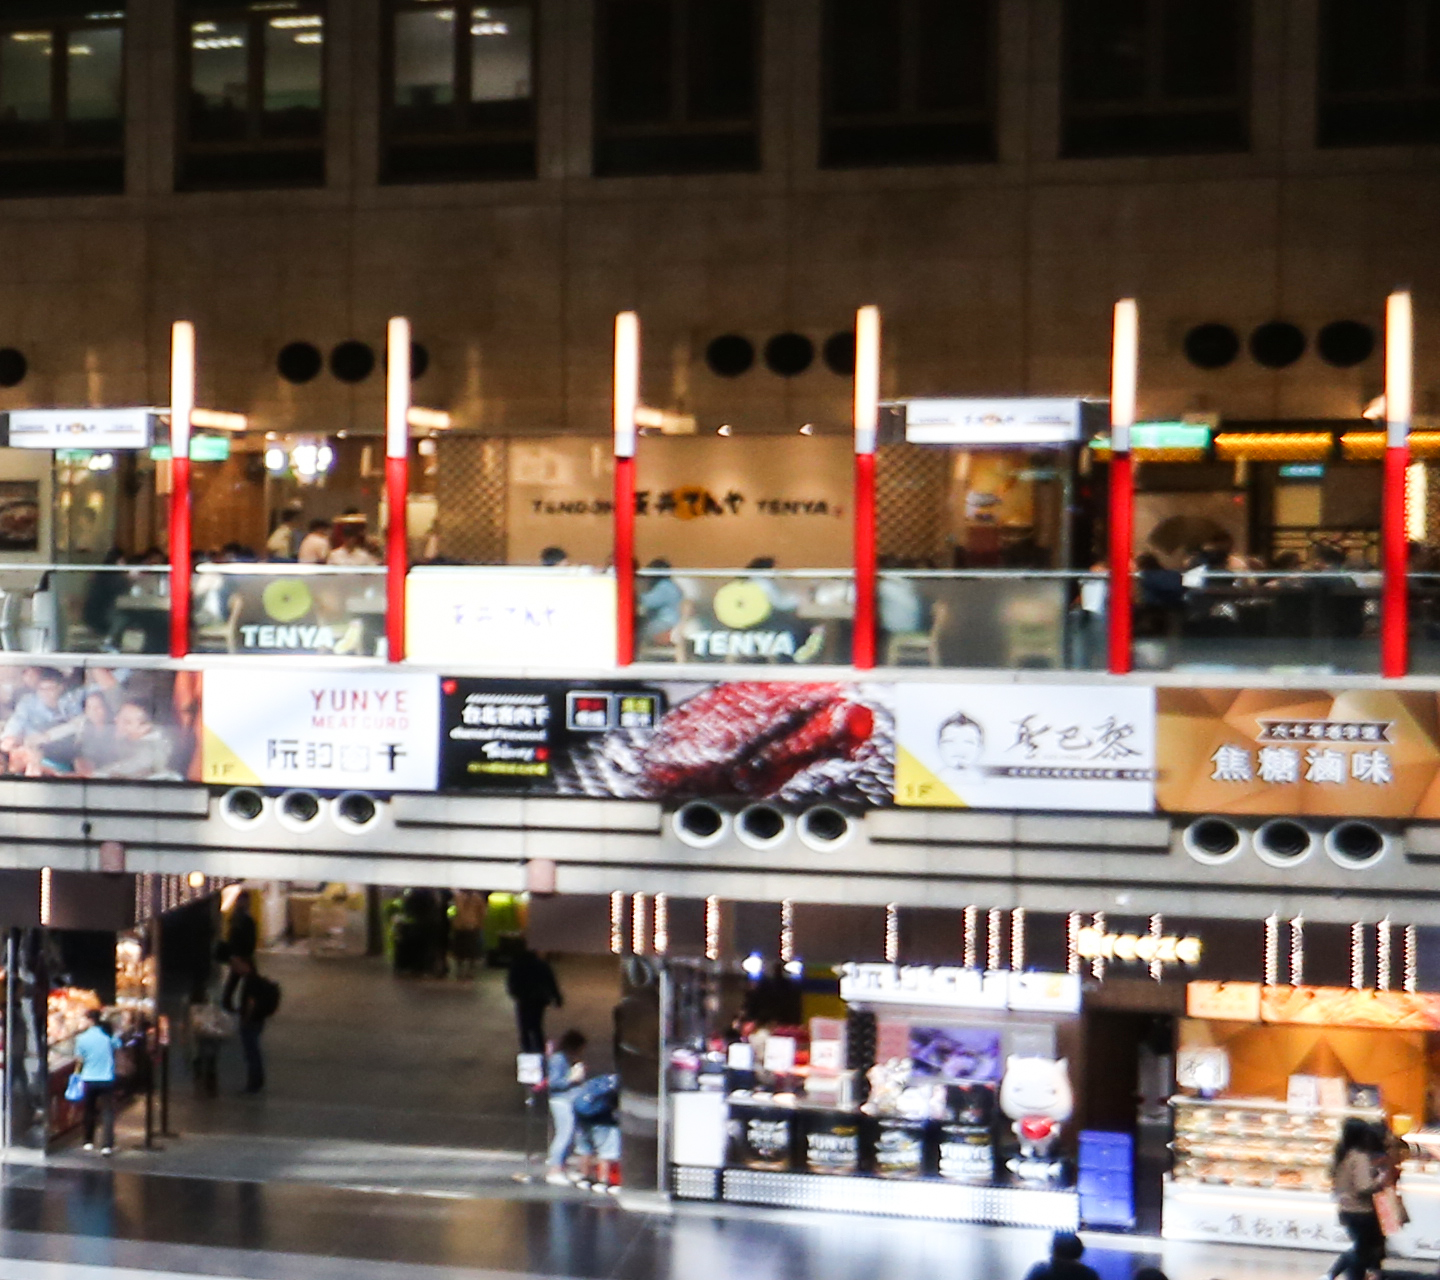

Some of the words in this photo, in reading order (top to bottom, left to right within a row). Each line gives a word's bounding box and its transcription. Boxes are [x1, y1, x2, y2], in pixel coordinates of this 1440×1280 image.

[240, 624, 335, 650] TENYA
[689, 631, 796, 656] TENYA
[310, 688, 408, 713] YUNYE
[311, 715, 357, 729] MEAT
[362, 716, 410, 730] CURD
[1210, 743, 1393, 786] 焦糖滷味
